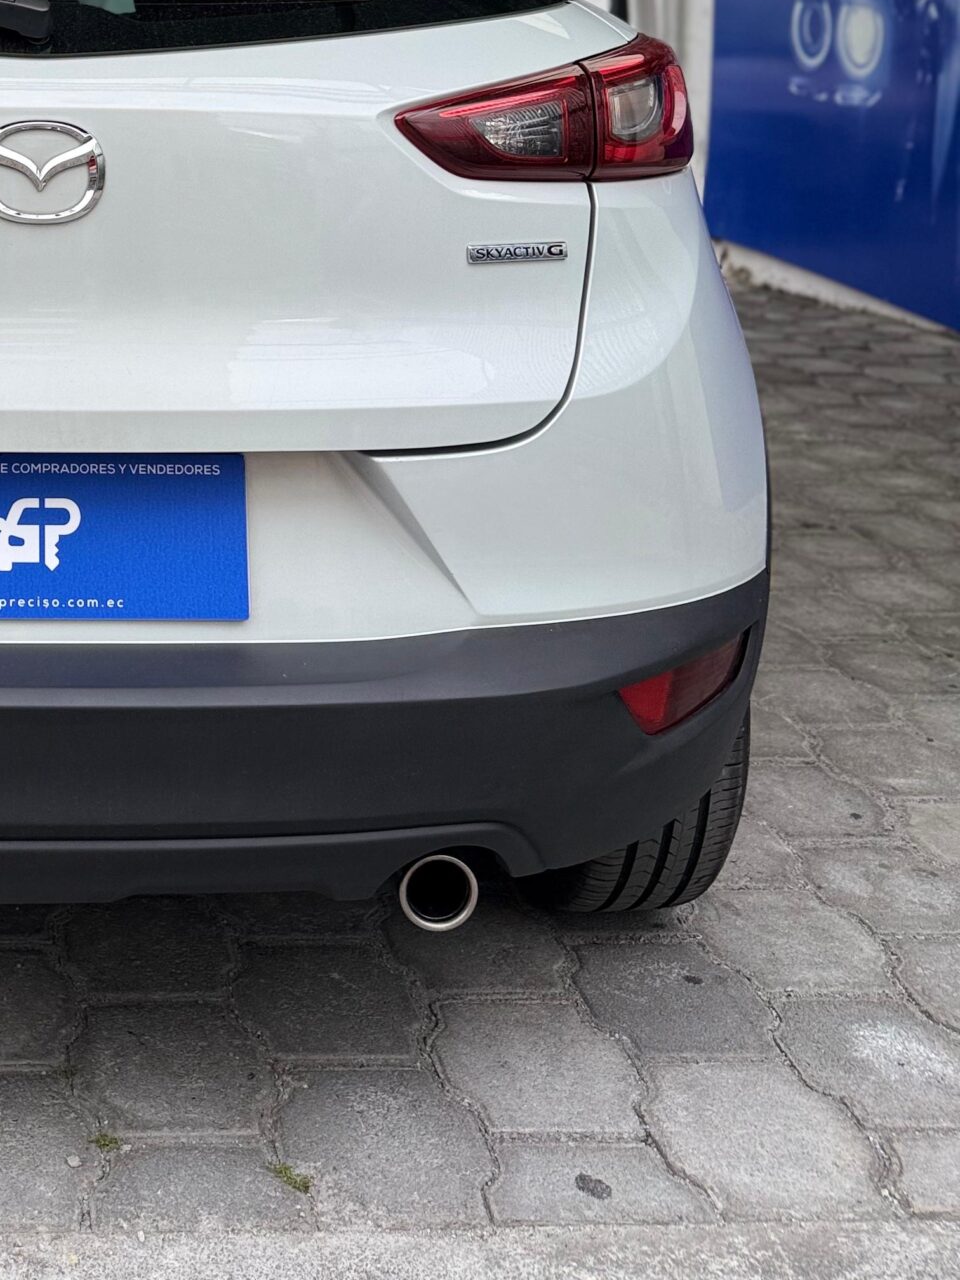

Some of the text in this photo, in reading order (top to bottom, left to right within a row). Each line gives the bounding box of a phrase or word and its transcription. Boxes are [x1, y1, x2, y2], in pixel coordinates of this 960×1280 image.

[11, 463, 116, 474] COMPRADORES
[119, 464, 127, 474] Y
[129, 464, 221, 475] VENDEDORES
